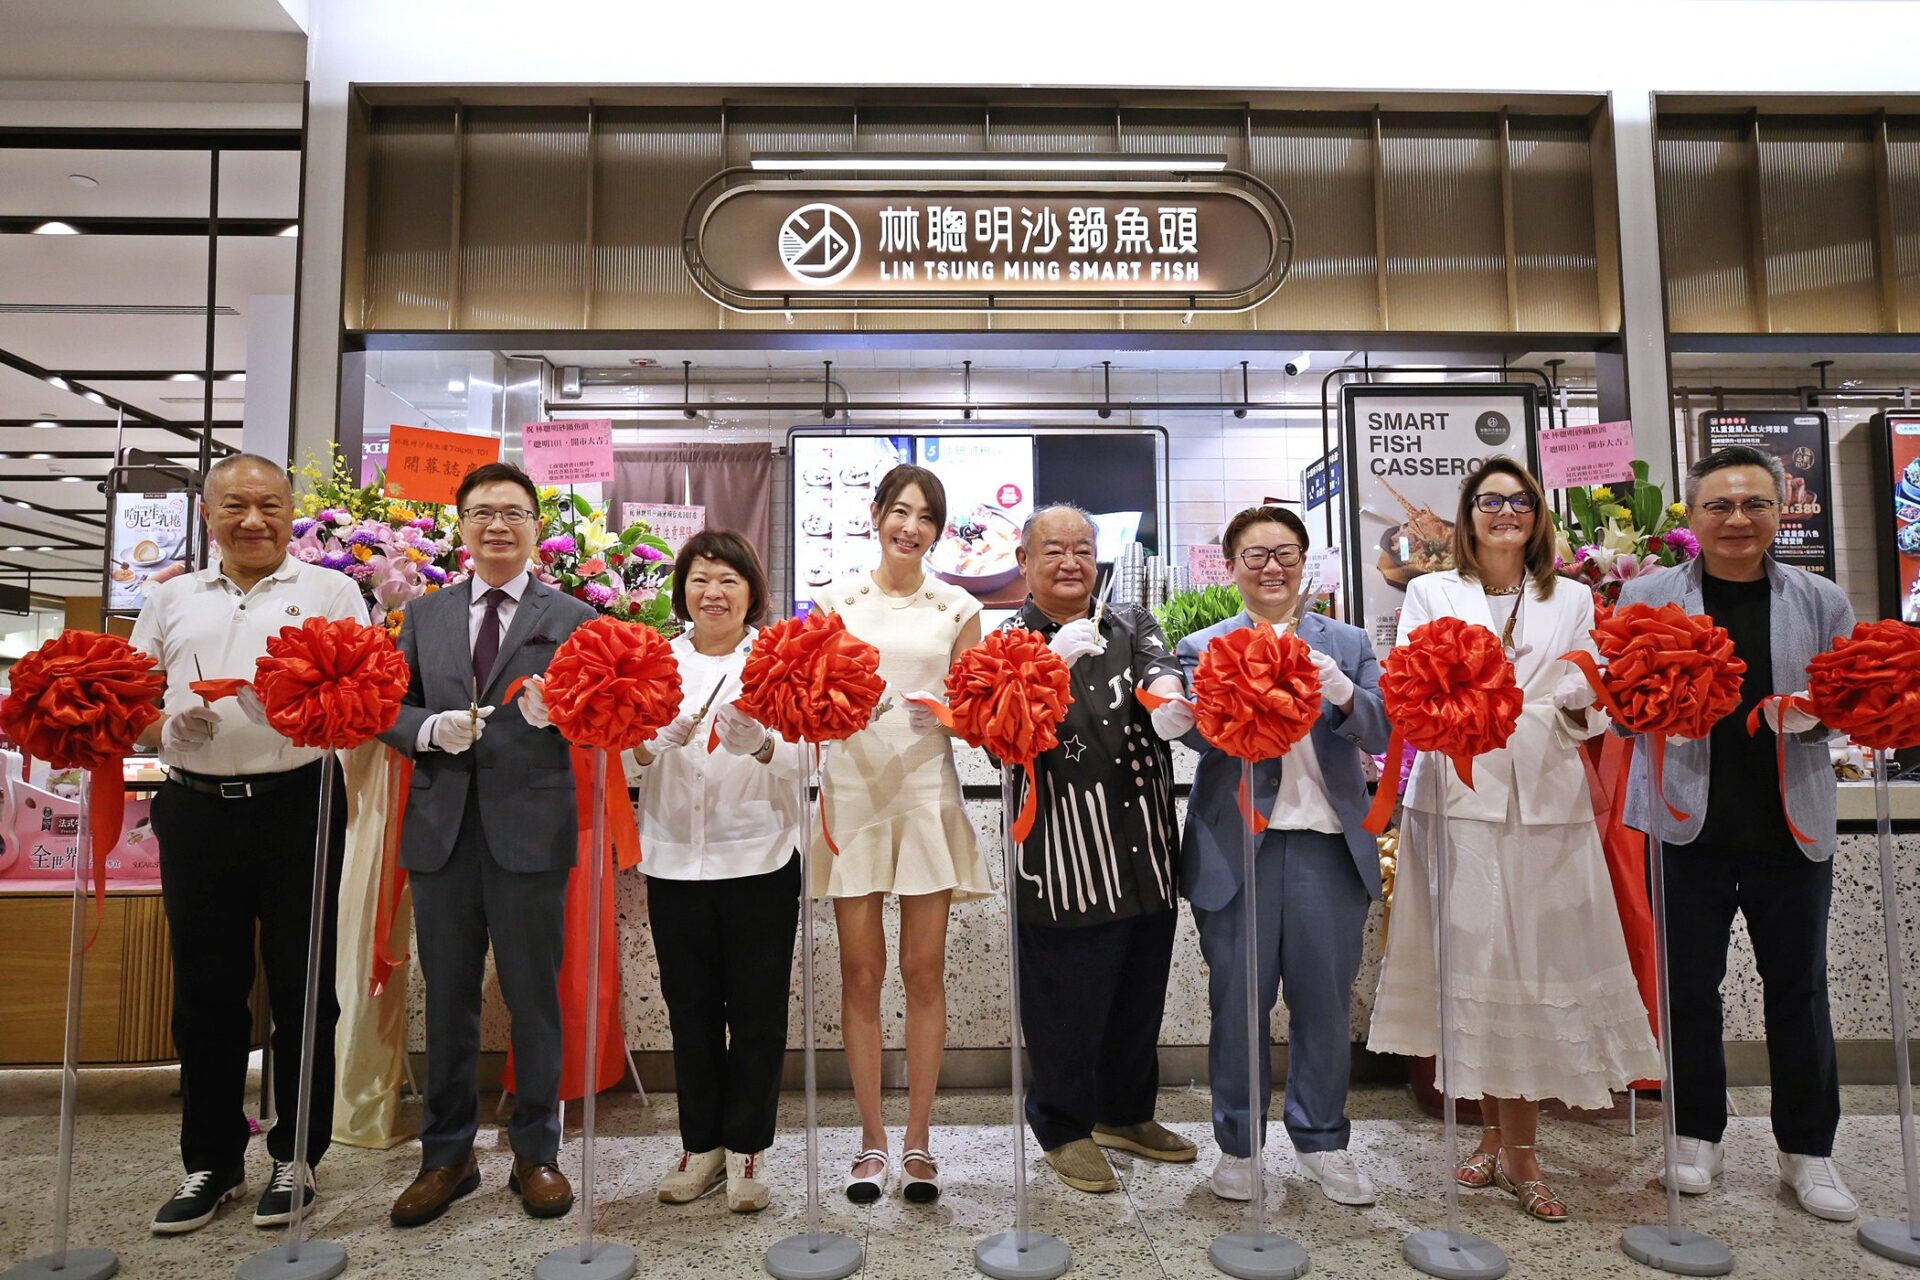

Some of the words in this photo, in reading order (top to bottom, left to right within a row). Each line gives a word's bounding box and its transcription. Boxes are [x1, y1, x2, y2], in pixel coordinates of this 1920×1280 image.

[879, 206, 1198, 253] 林聰明沙鍋魚頭
[880, 261, 915, 281] LIN
[924, 261, 994, 281] TSUNG
[1004, 261, 1061, 281] MING
[1069, 261, 1142, 281] SMART
[1151, 261, 1199, 281] FISH
[1368, 413, 1449, 430] SMART
[927, 446, 937, 457] 5
[1370, 435, 1422, 453] FISH
